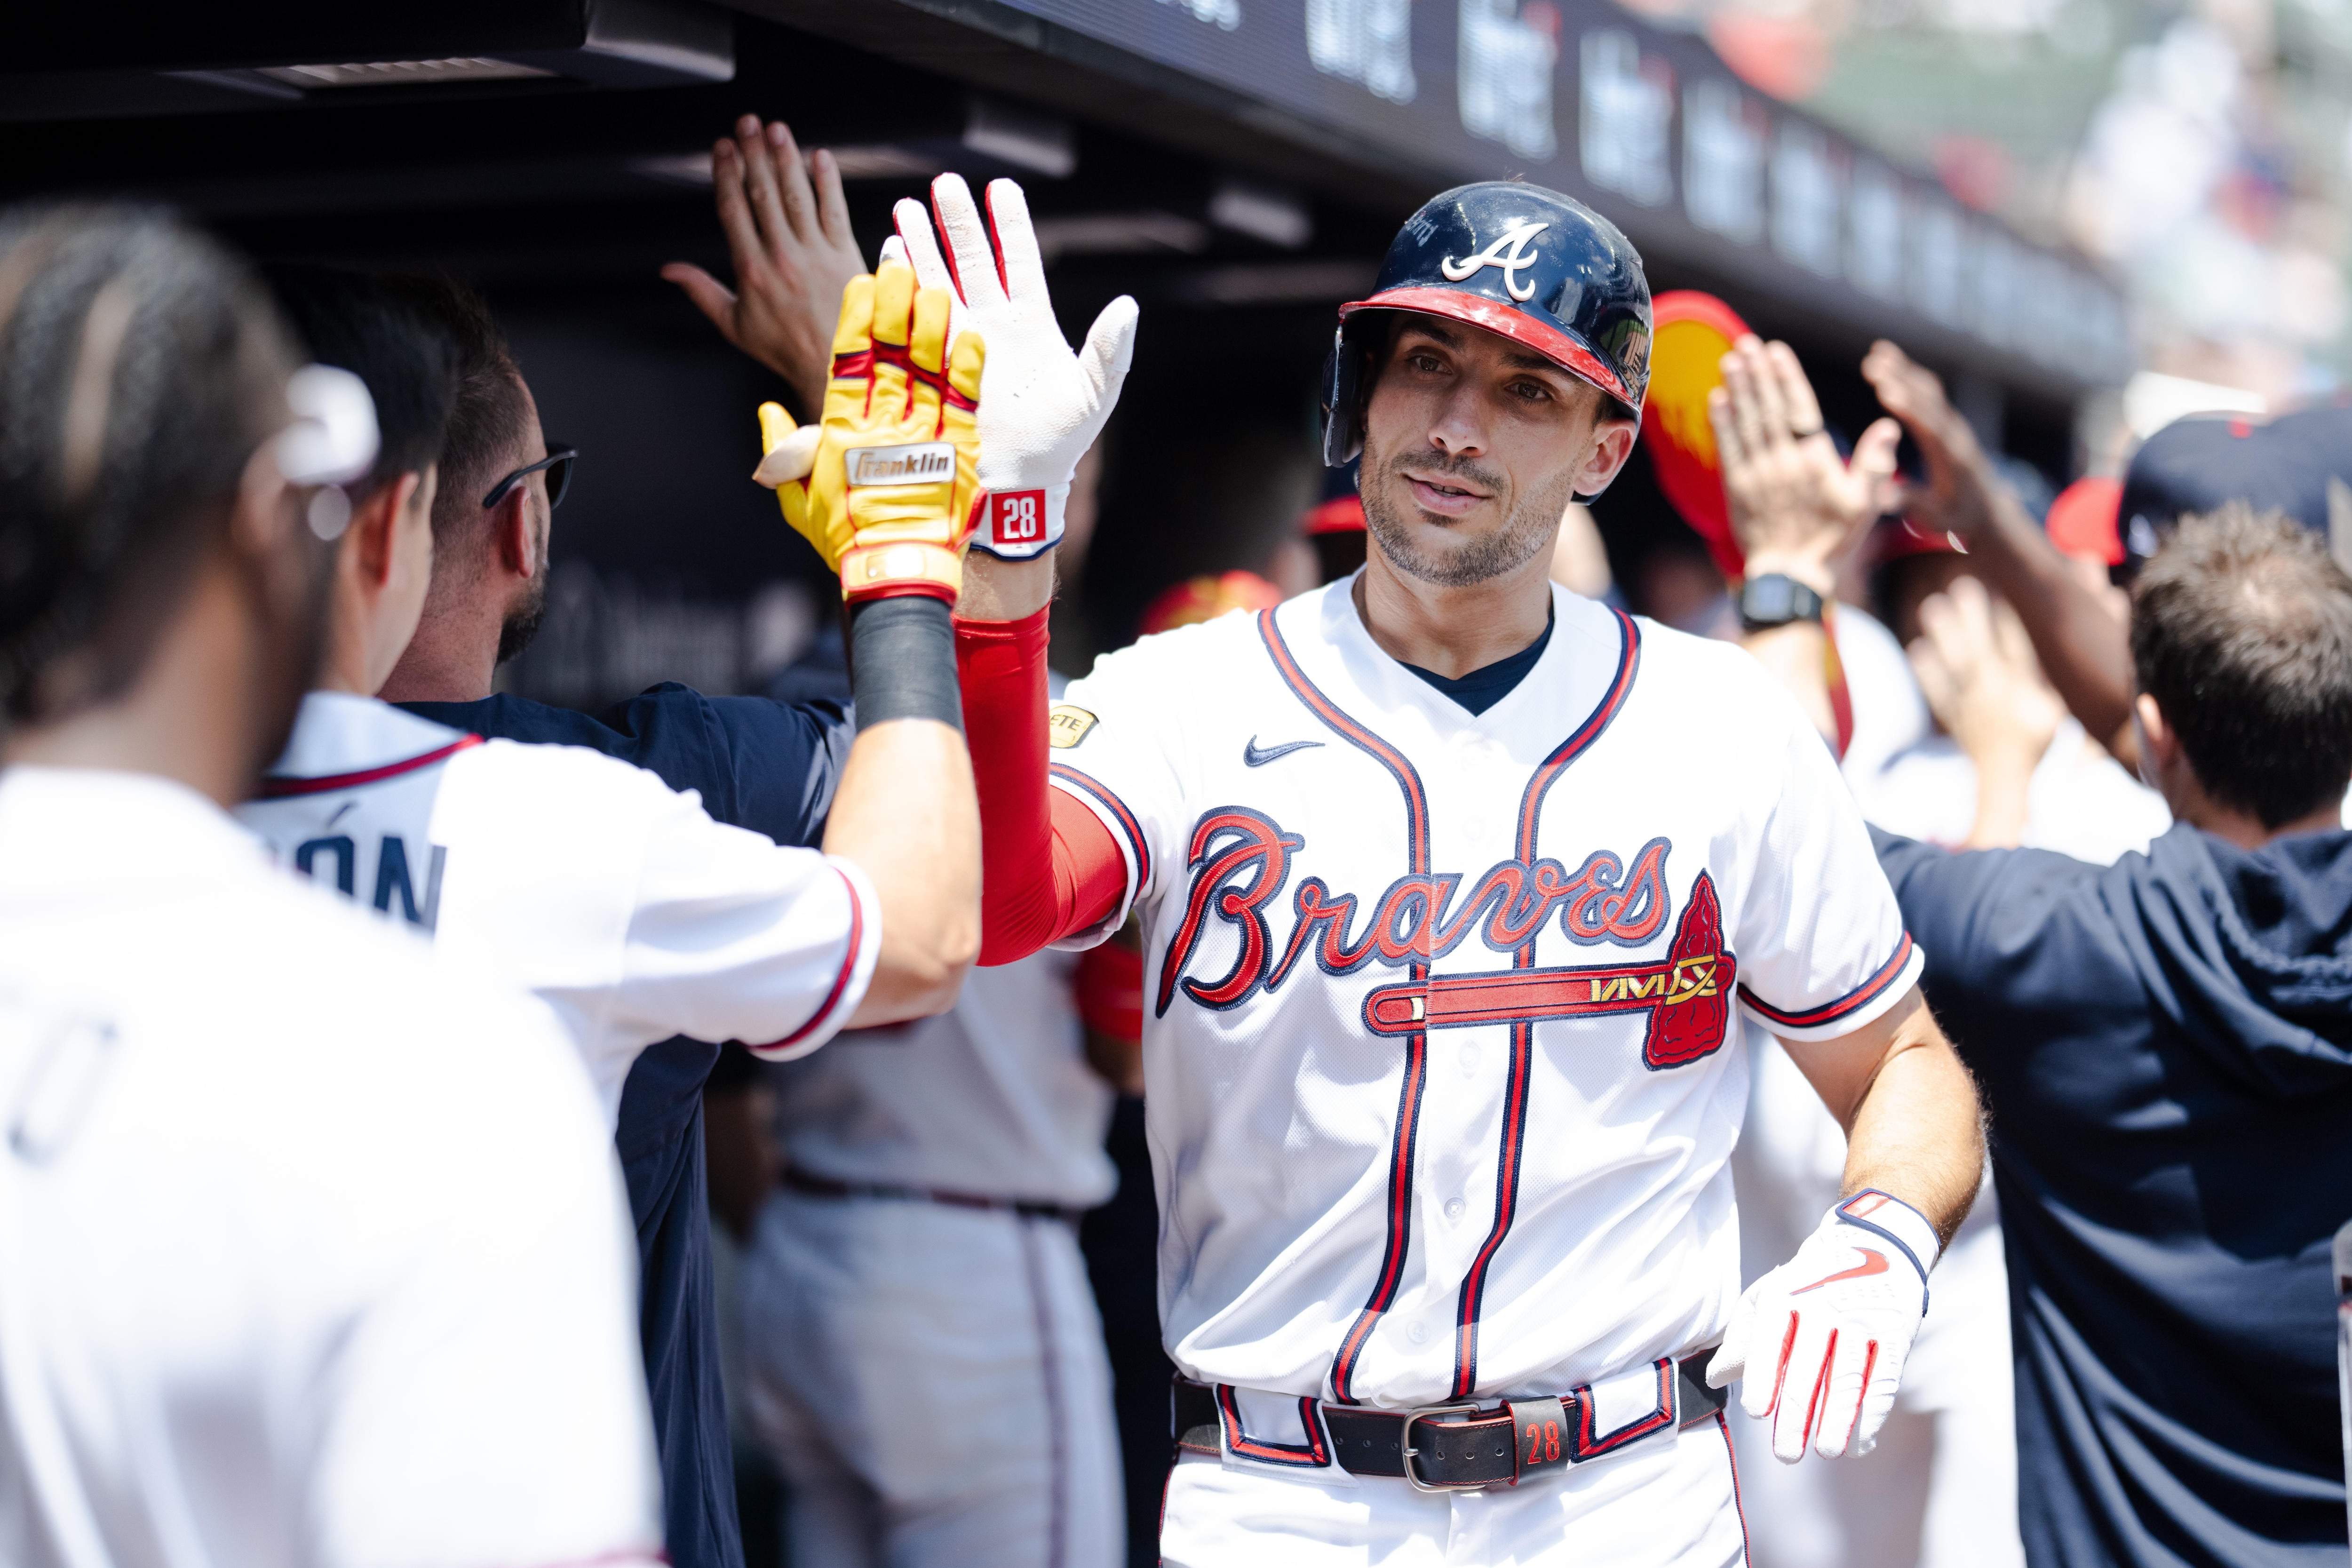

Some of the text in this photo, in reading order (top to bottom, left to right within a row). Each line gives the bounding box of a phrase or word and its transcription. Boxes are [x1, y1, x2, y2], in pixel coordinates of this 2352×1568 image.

[1442, 223, 1549, 302] A
[855, 452, 949, 481] Franklin
[1002, 496, 1036, 540] 28
[1049, 714, 1083, 732] ETE
[294, 801, 448, 936] ÓN
[1155, 806, 1672, 1019] Braves
[1526, 1419, 1560, 1465] 28
